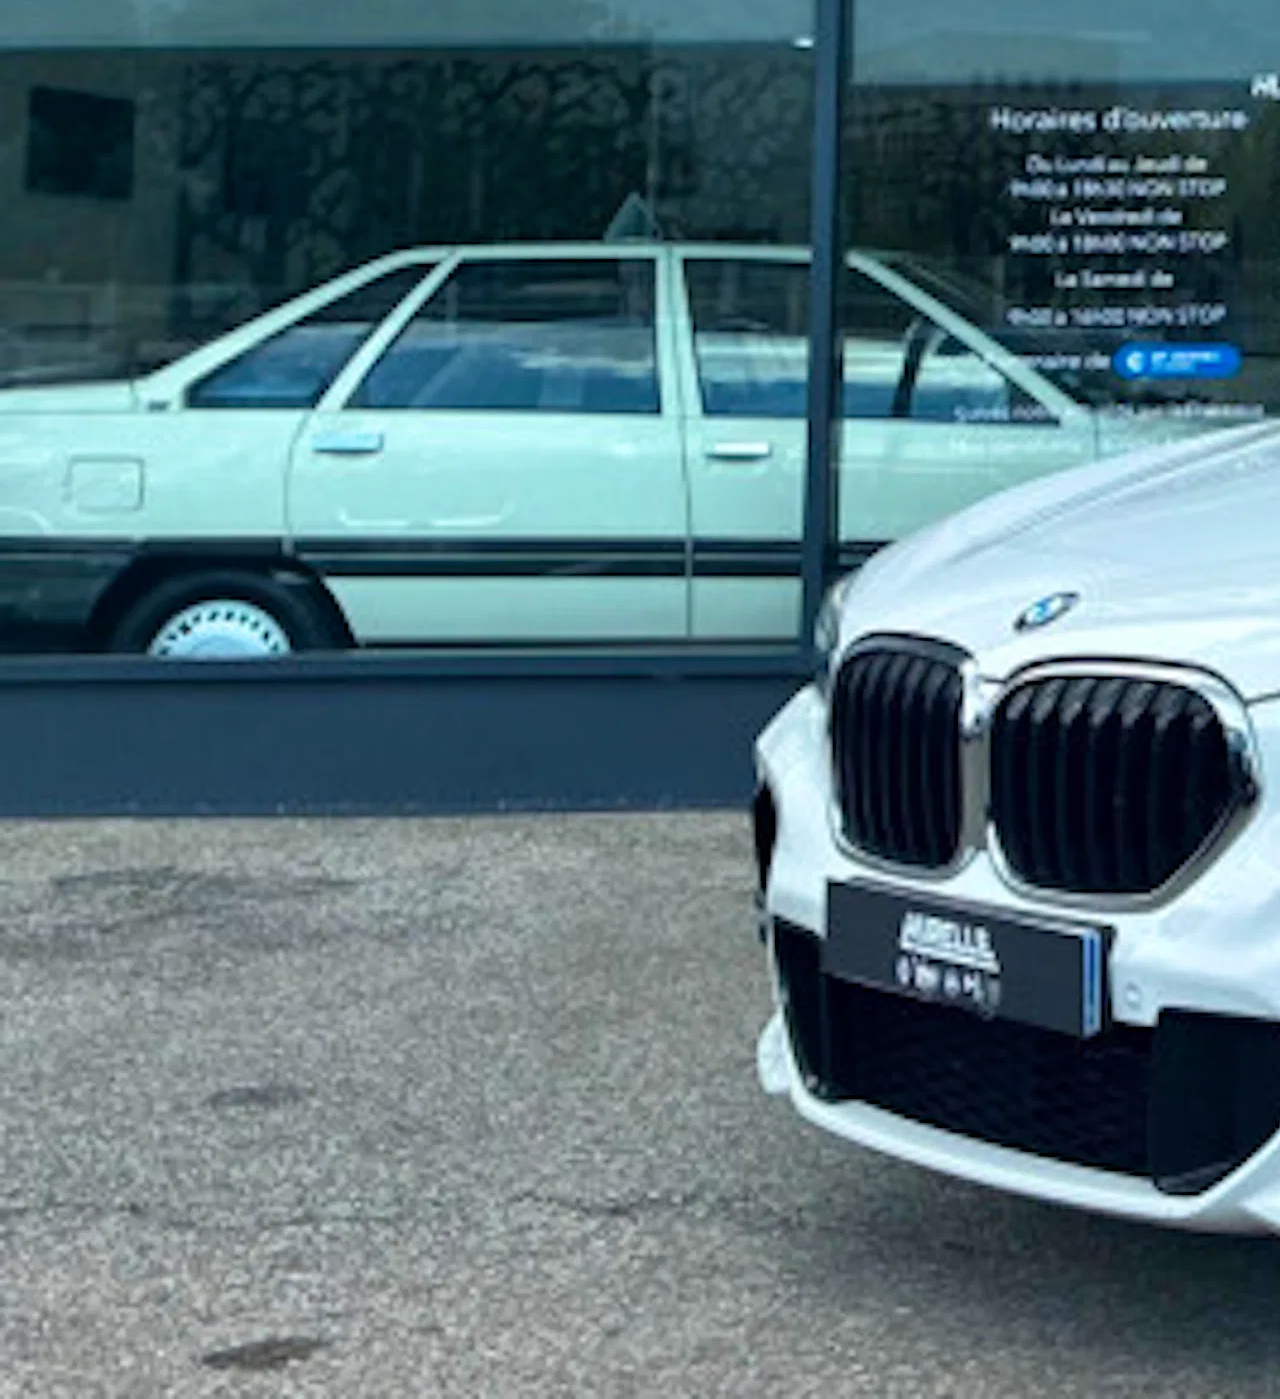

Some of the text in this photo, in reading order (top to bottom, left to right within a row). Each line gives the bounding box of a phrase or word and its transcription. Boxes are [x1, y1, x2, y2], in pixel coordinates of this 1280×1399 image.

[989, 105, 1248, 133] Horaires d'ouverture
[1127, 178, 1174, 197] NON
[1178, 177, 1227, 198] STOP
[1129, 233, 1176, 253] NON
[1179, 232, 1228, 253] STOP
[1127, 305, 1174, 326] NON
[1176, 304, 1227, 326] STOP
